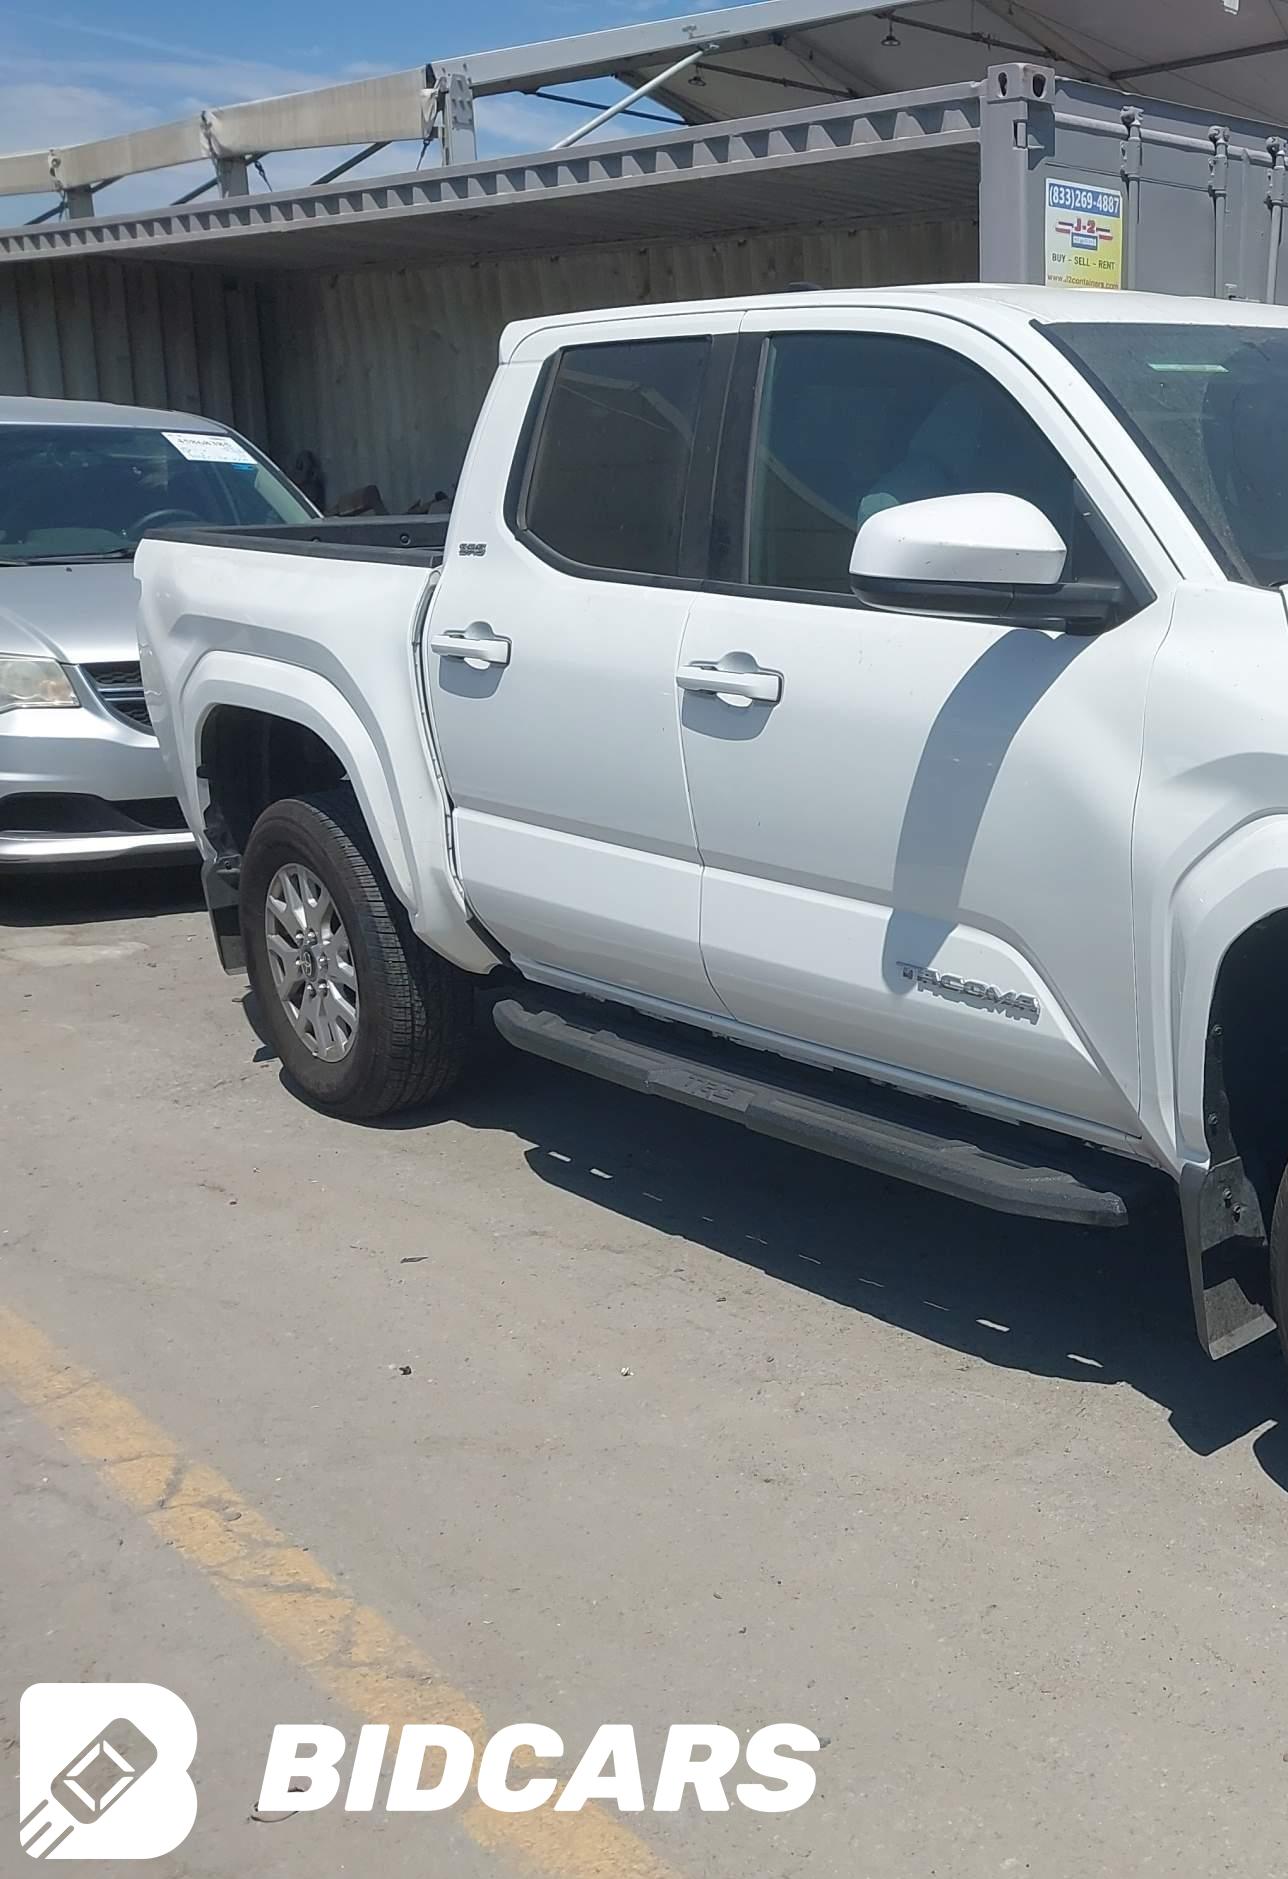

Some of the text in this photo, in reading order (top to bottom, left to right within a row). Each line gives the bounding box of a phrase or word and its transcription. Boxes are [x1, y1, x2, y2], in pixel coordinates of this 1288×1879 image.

[1049, 185, 1120, 214] (833)269-4887
[1074, 218, 1096, 233] J-2
[1051, 253, 1066, 263] BUY
[1074, 256, 1091, 267] SELL
[1098, 260, 1116, 270] RENT
[896, 960, 1041, 1016] TACOMA
